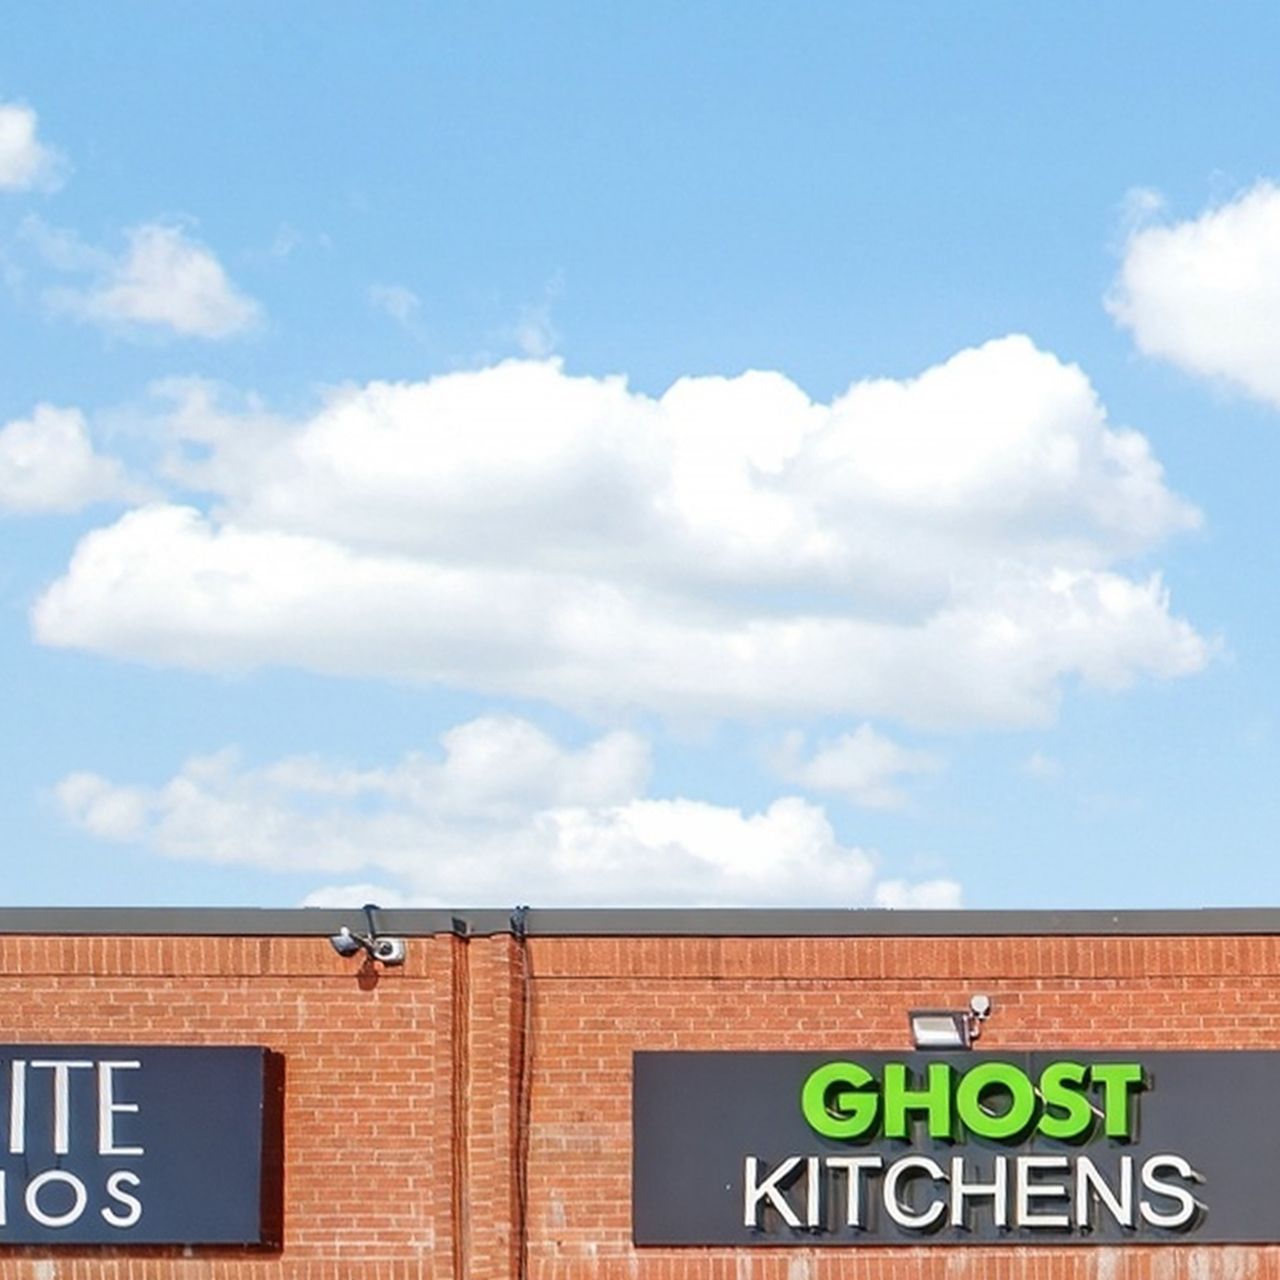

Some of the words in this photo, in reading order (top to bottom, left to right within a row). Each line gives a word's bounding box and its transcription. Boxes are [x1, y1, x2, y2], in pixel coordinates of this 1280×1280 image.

[9, 1059, 145, 1156] ITE
[801, 1061, 1142, 1139] GHOST
[743, 1154, 1197, 1228] KITCHENS
